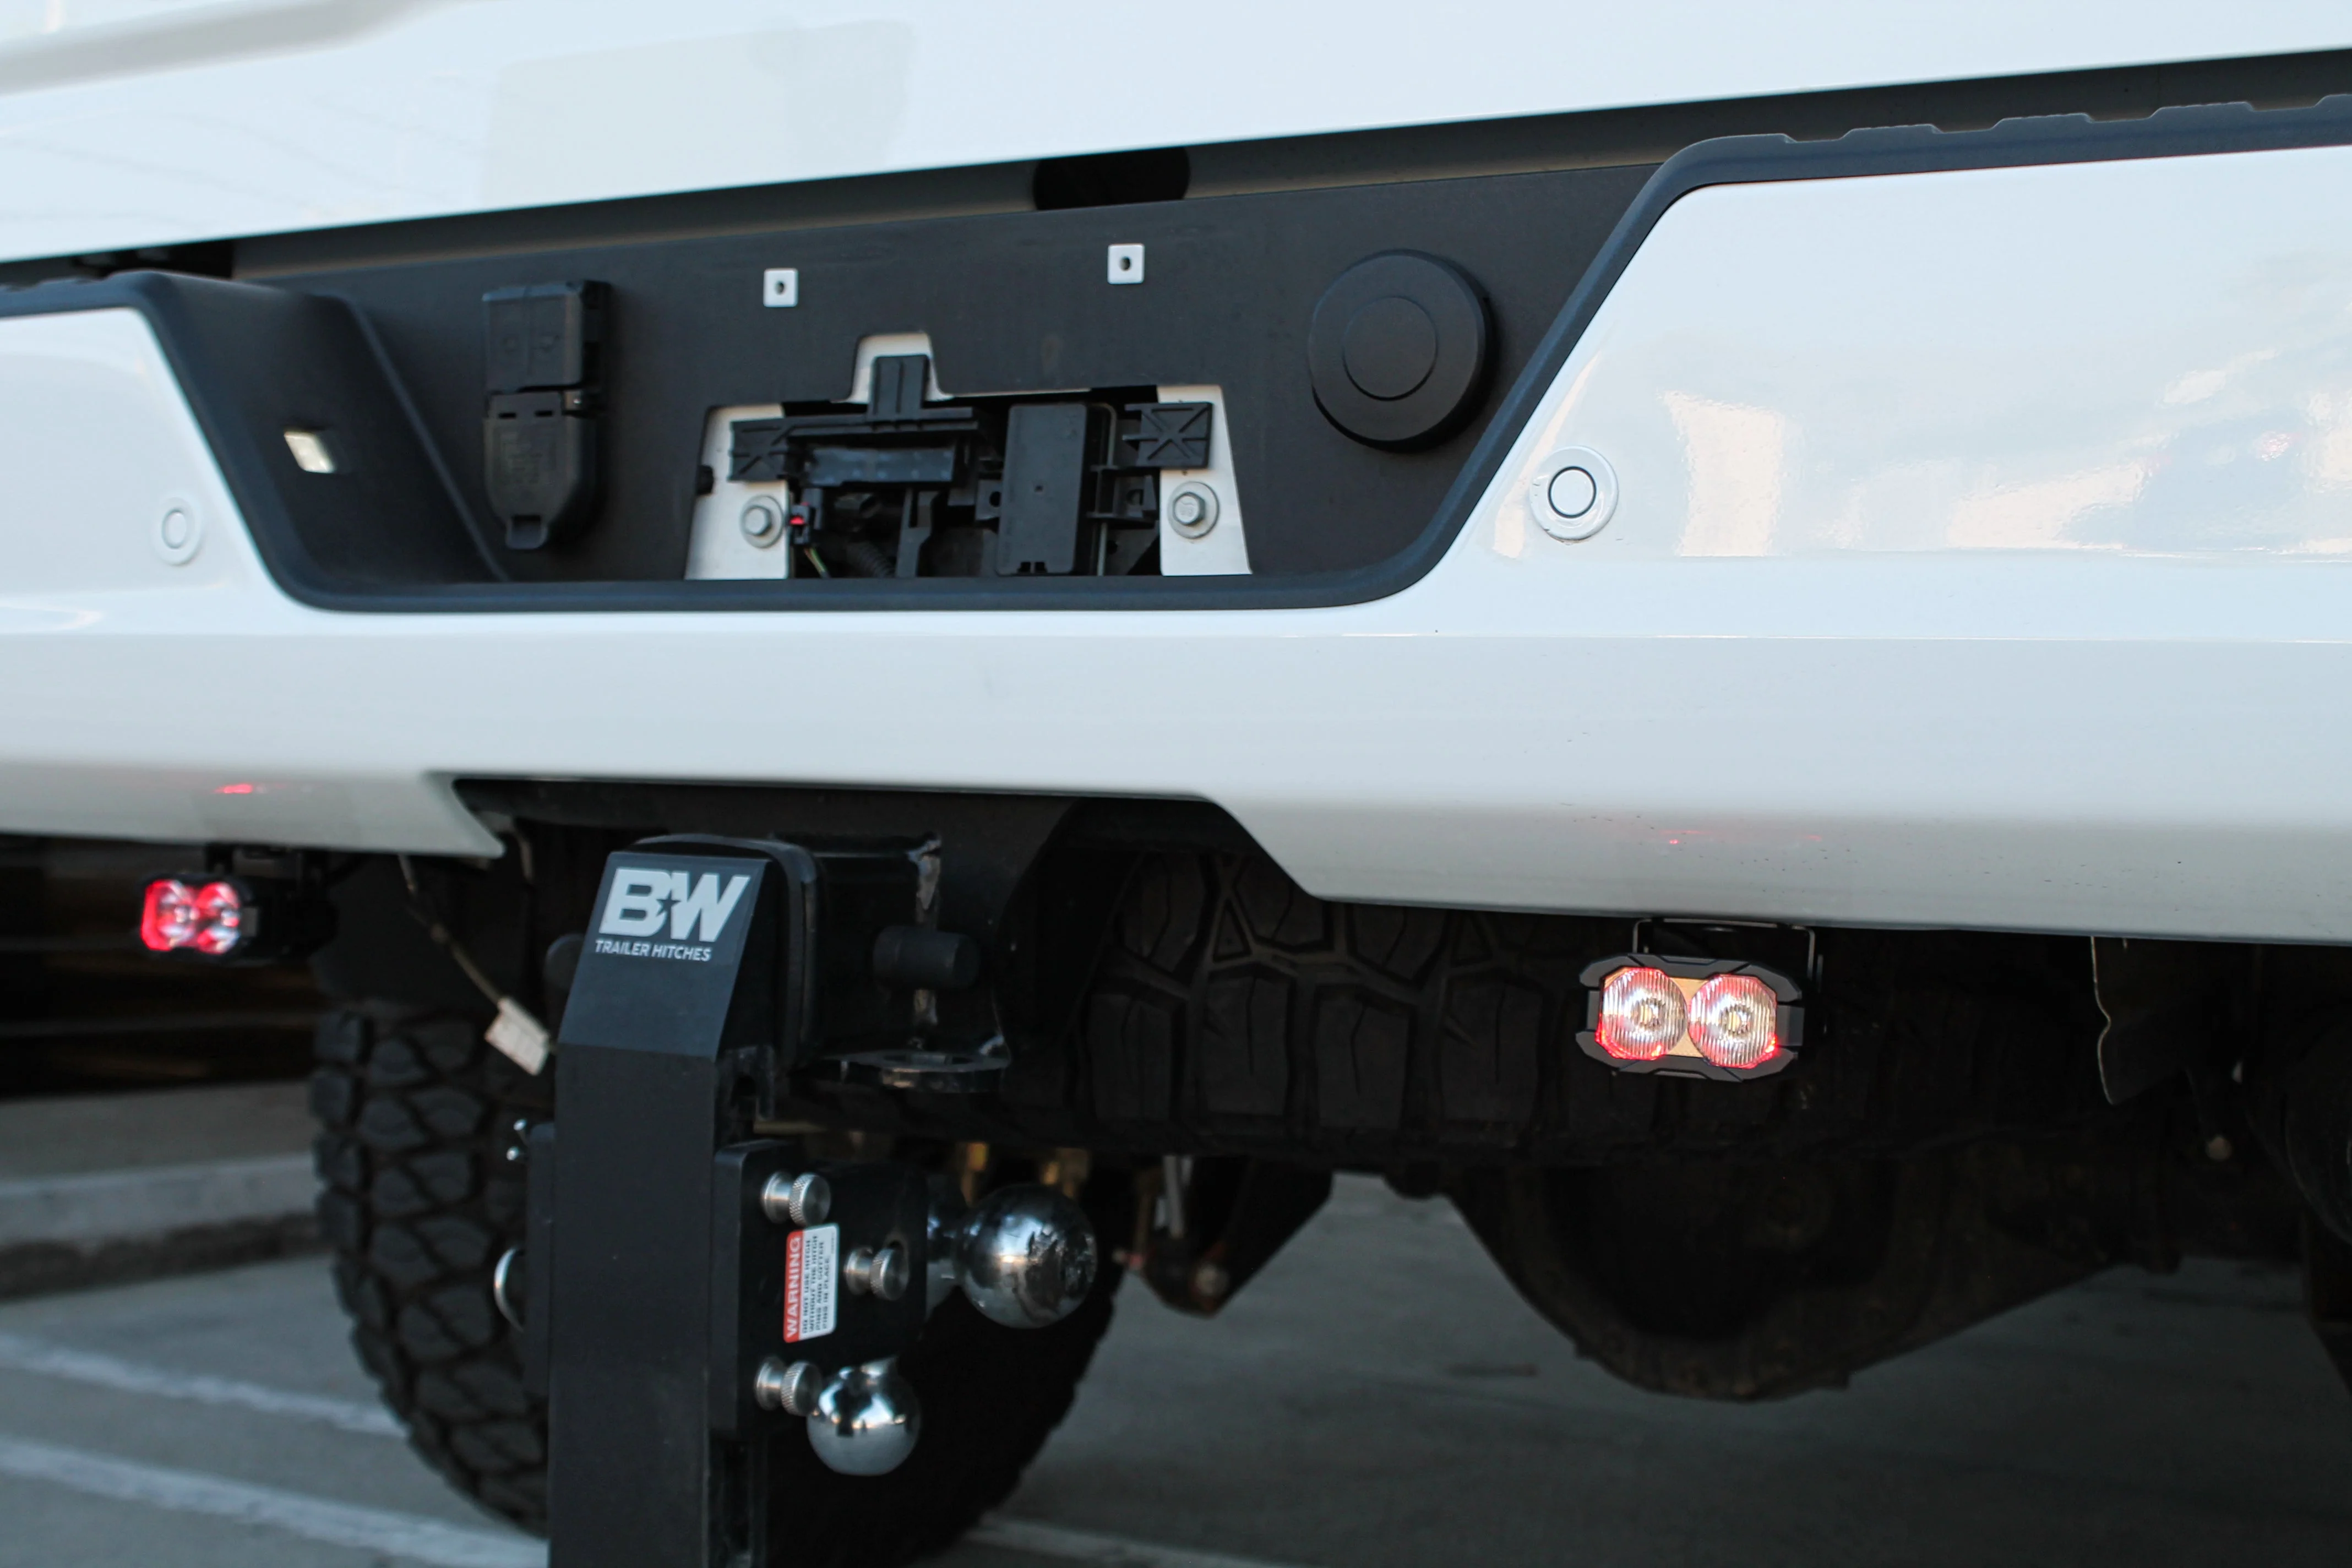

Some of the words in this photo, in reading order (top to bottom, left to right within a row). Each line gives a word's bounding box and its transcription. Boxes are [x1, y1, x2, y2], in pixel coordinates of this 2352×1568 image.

[595, 939, 650, 956] TRAILER
[651, 944, 712, 961] HITCHES
[786, 1237, 801, 1338] WARNING
